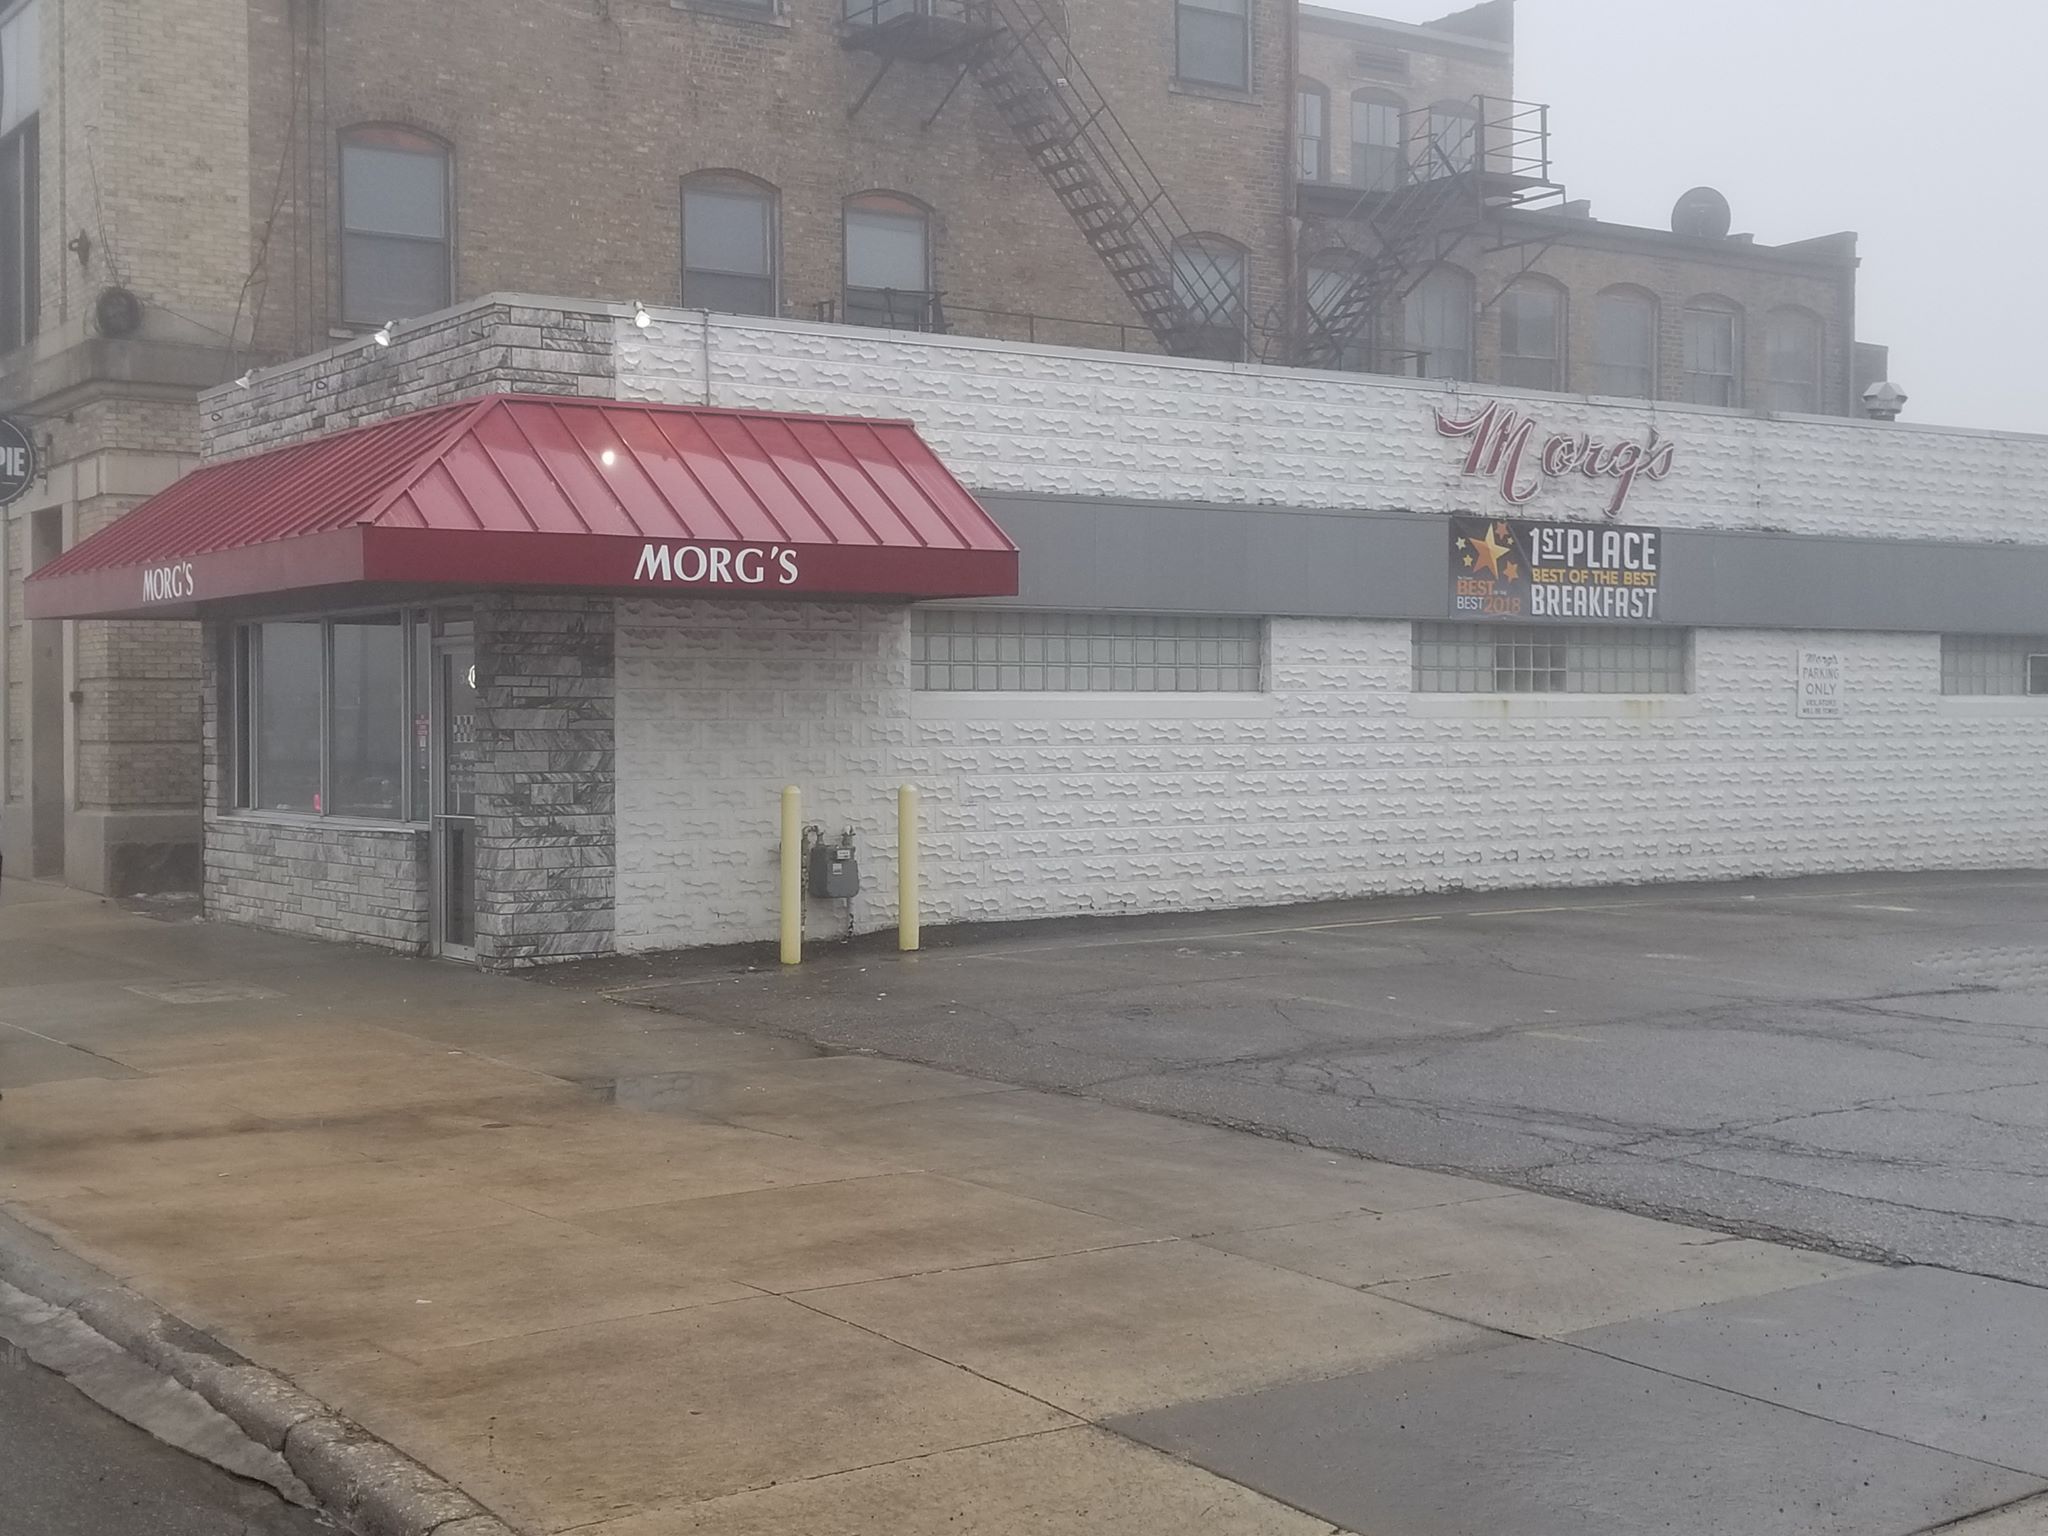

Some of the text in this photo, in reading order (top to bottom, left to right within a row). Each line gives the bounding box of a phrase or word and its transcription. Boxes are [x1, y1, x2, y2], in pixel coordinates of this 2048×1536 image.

[1434, 399, 1675, 519] Morg's
[1529, 527, 1657, 570] 1ST PLACE
[633, 543, 799, 584] MORG'S
[142, 561, 194, 602] MORG'S
[1456, 580, 1495, 596] BEST
[1532, 568, 1657, 586] BEST OF THE BEST
[1457, 596, 1521, 614] BEST 2018
[1531, 584, 1657, 618] BREAKFAST
[1802, 667, 1840, 680] PARKING
[1806, 683, 1837, 695] ONLY
